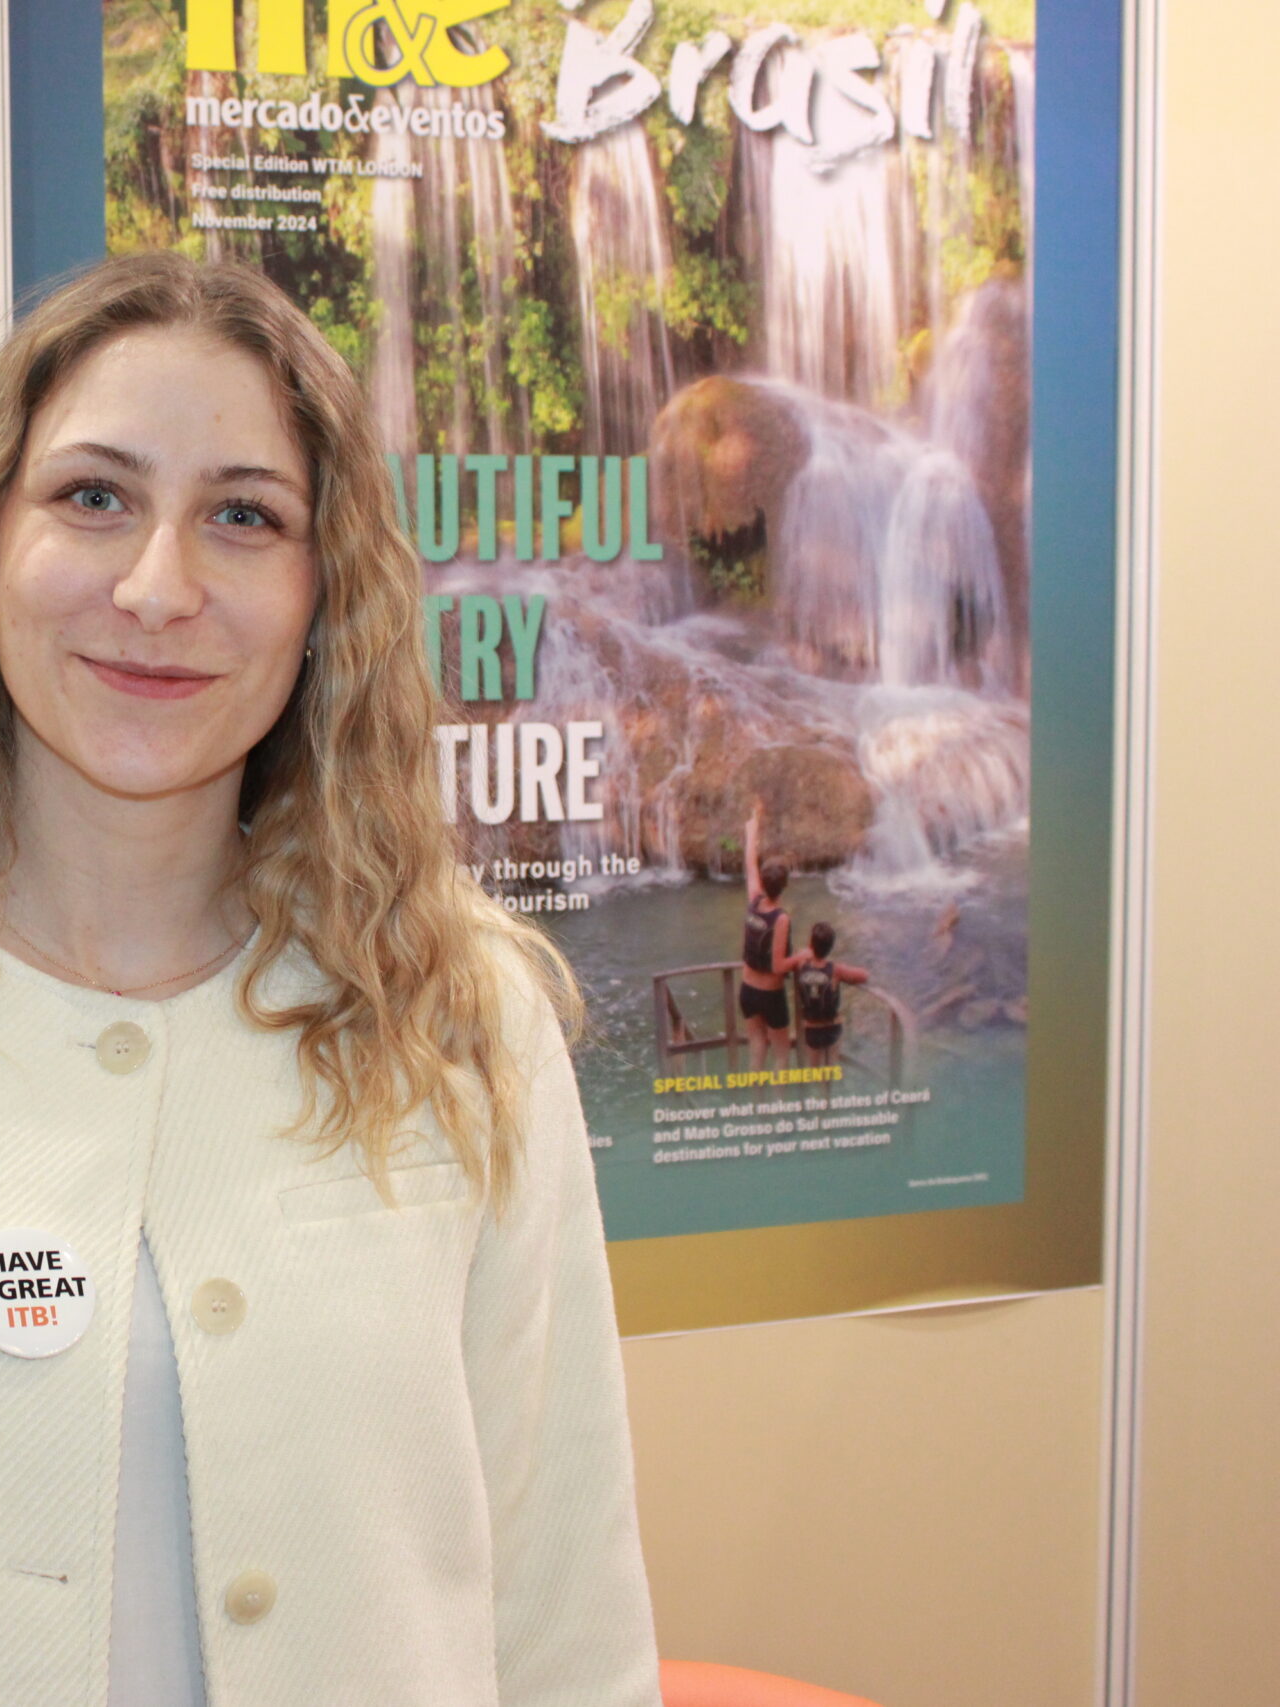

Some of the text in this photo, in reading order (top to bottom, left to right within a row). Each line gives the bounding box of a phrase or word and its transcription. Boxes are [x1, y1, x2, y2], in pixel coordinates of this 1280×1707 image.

[539, 0, 982, 174] Brasil
[186, 94, 506, 139] mercado&eventos
[191, 154, 423, 177] Special Edition WTM LONDON
[191, 183, 321, 203] Free distribution
[191, 212, 317, 231] November 2024
[493, 855, 592, 882] through
[600, 853, 640, 875] the
[654, 1066, 842, 1094] SPECIAL SUPPLEMENTS
[653, 1088, 931, 1123] Discover what makes the states of Ceará
[653, 1111, 899, 1143] and Mato Grosso do Sul unmissable
[653, 1132, 891, 1164] destinations for your next vacation
[7, 1305, 58, 1328] ITB!
